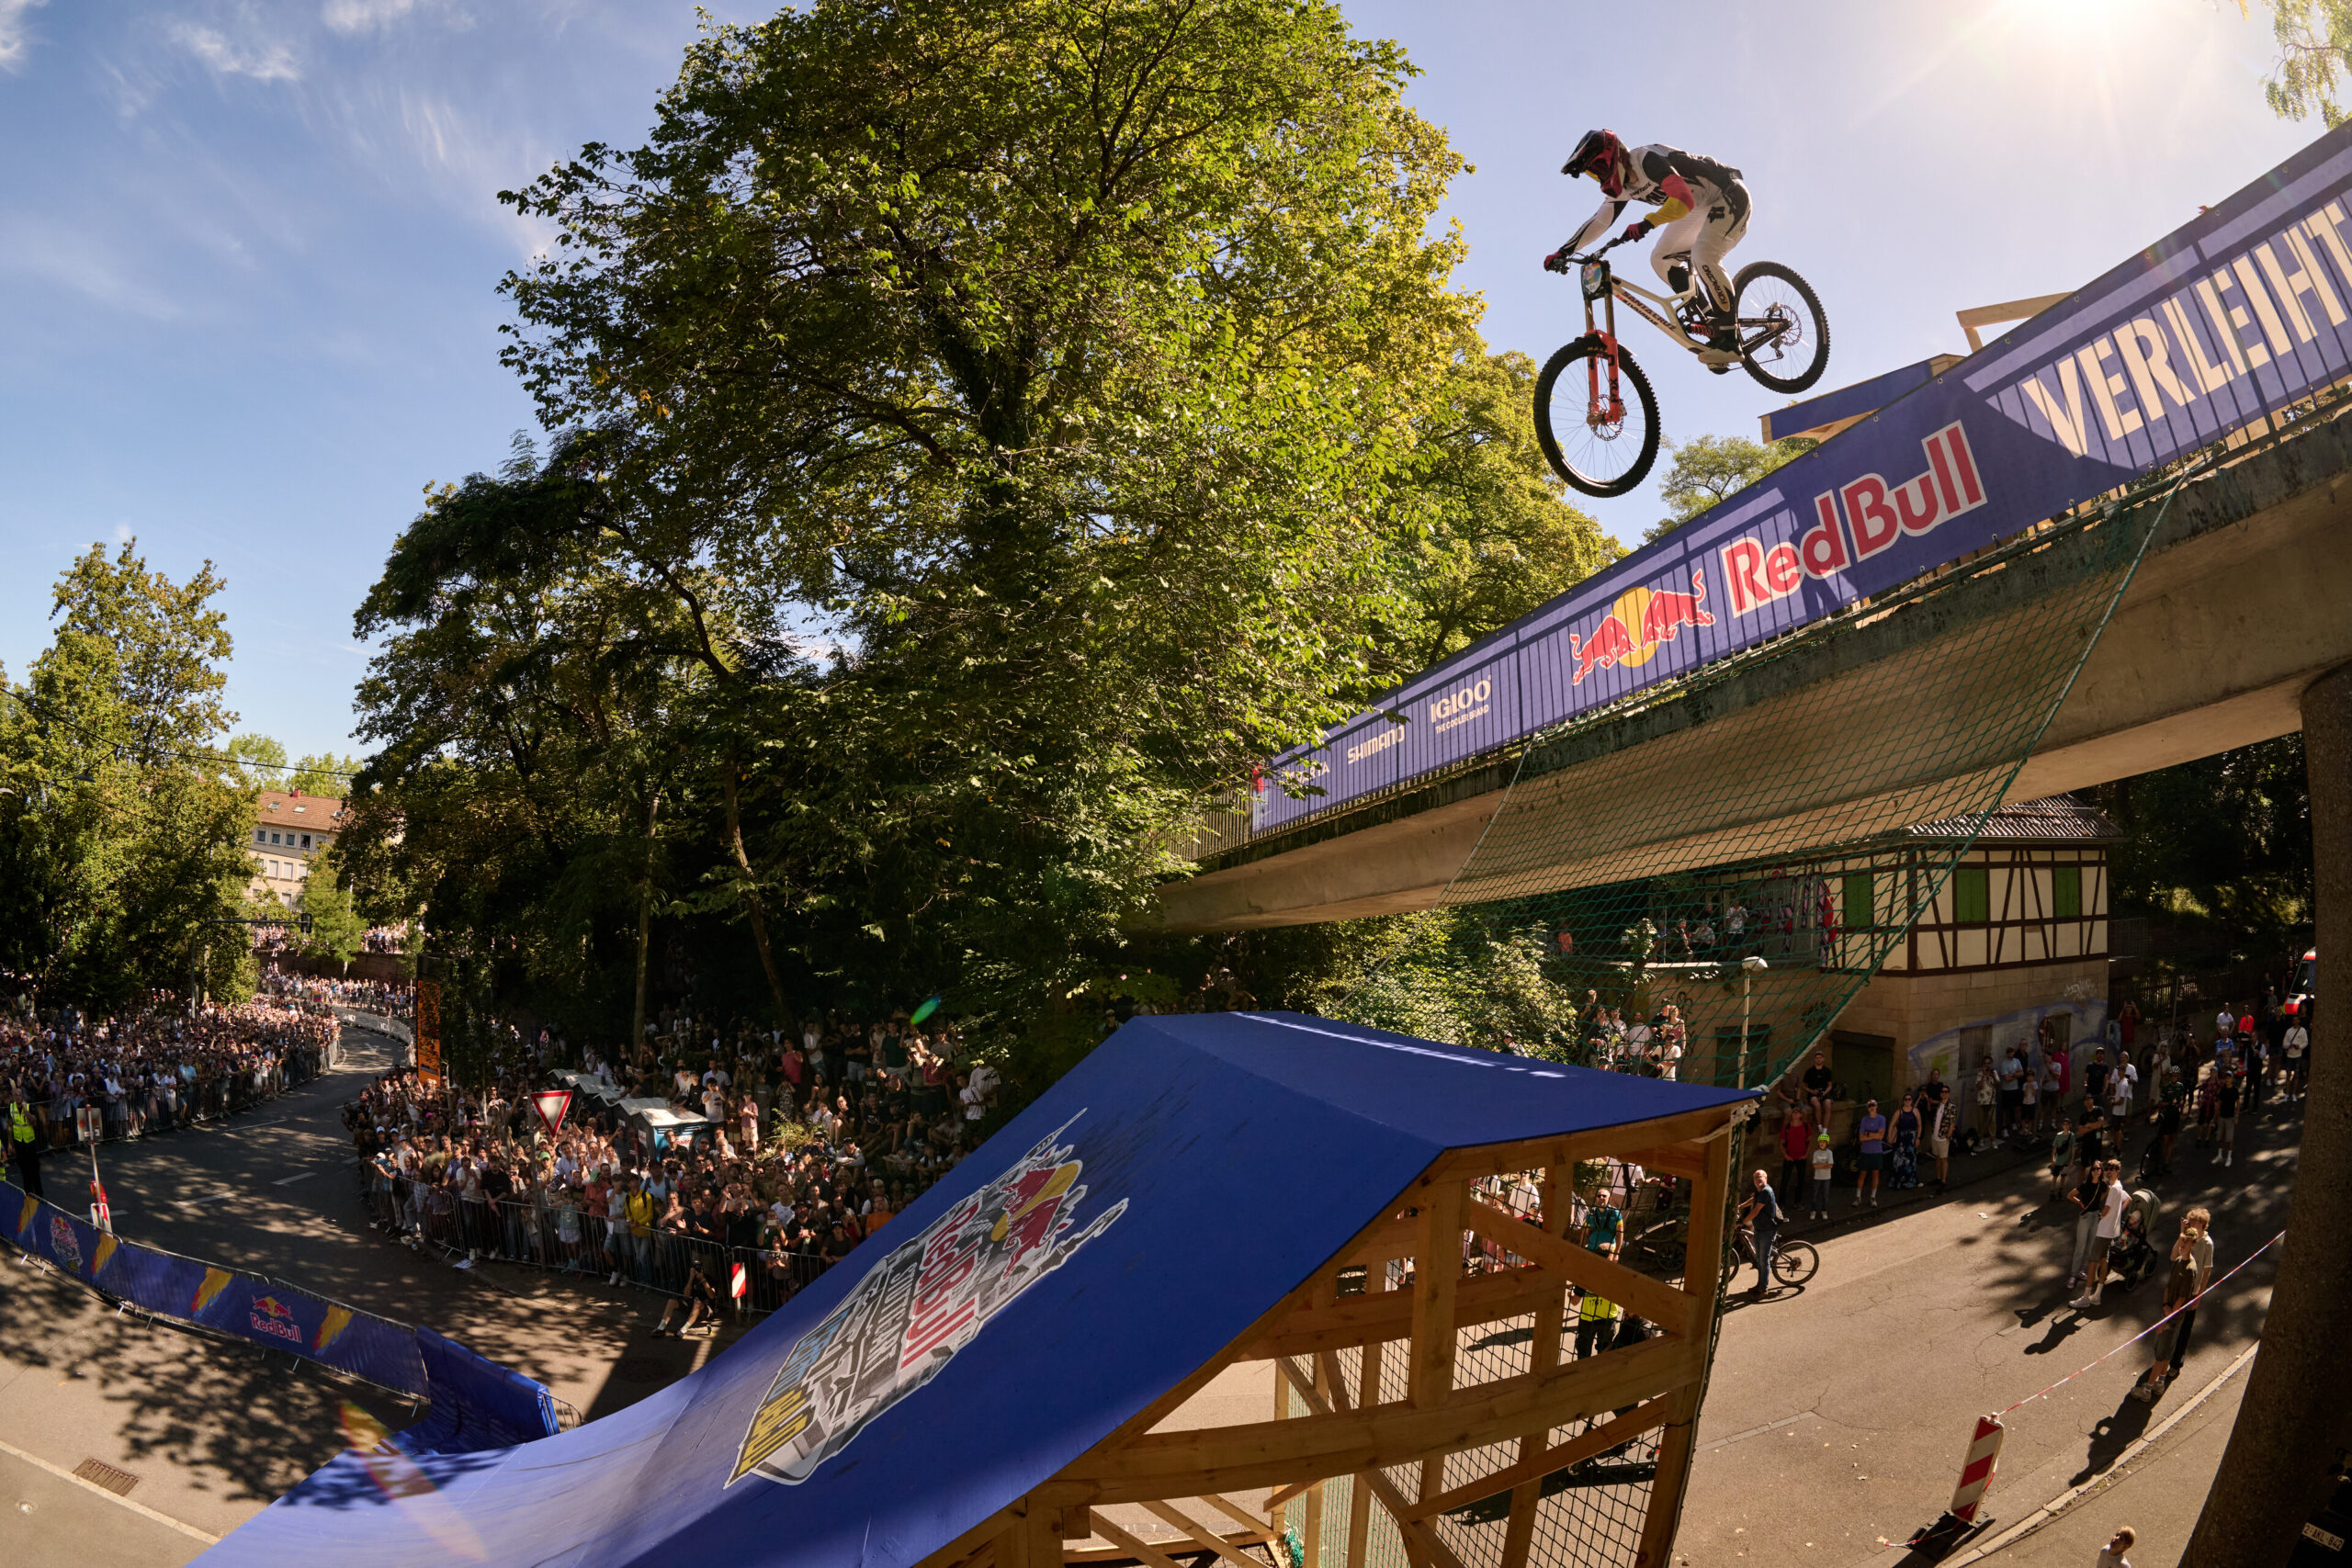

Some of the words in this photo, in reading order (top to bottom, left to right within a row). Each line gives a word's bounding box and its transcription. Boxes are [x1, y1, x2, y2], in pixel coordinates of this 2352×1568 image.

[1622, 291, 1653, 316] SANTA
[1652, 310, 1677, 331] CRUZ
[2022, 202, 2352, 458] VERLEIHT
[1430, 680, 1491, 723] IGLOO
[1435, 723, 1446, 735] THE
[1445, 713, 1469, 729] COOLER
[1469, 704, 1489, 720] BRAND
[1347, 725, 1406, 765] SHIMANO
[862, 1262, 918, 1379] STUTTGART
[767, 1308, 851, 1402] CERRO
[738, 1389, 808, 1475] ABAJO
